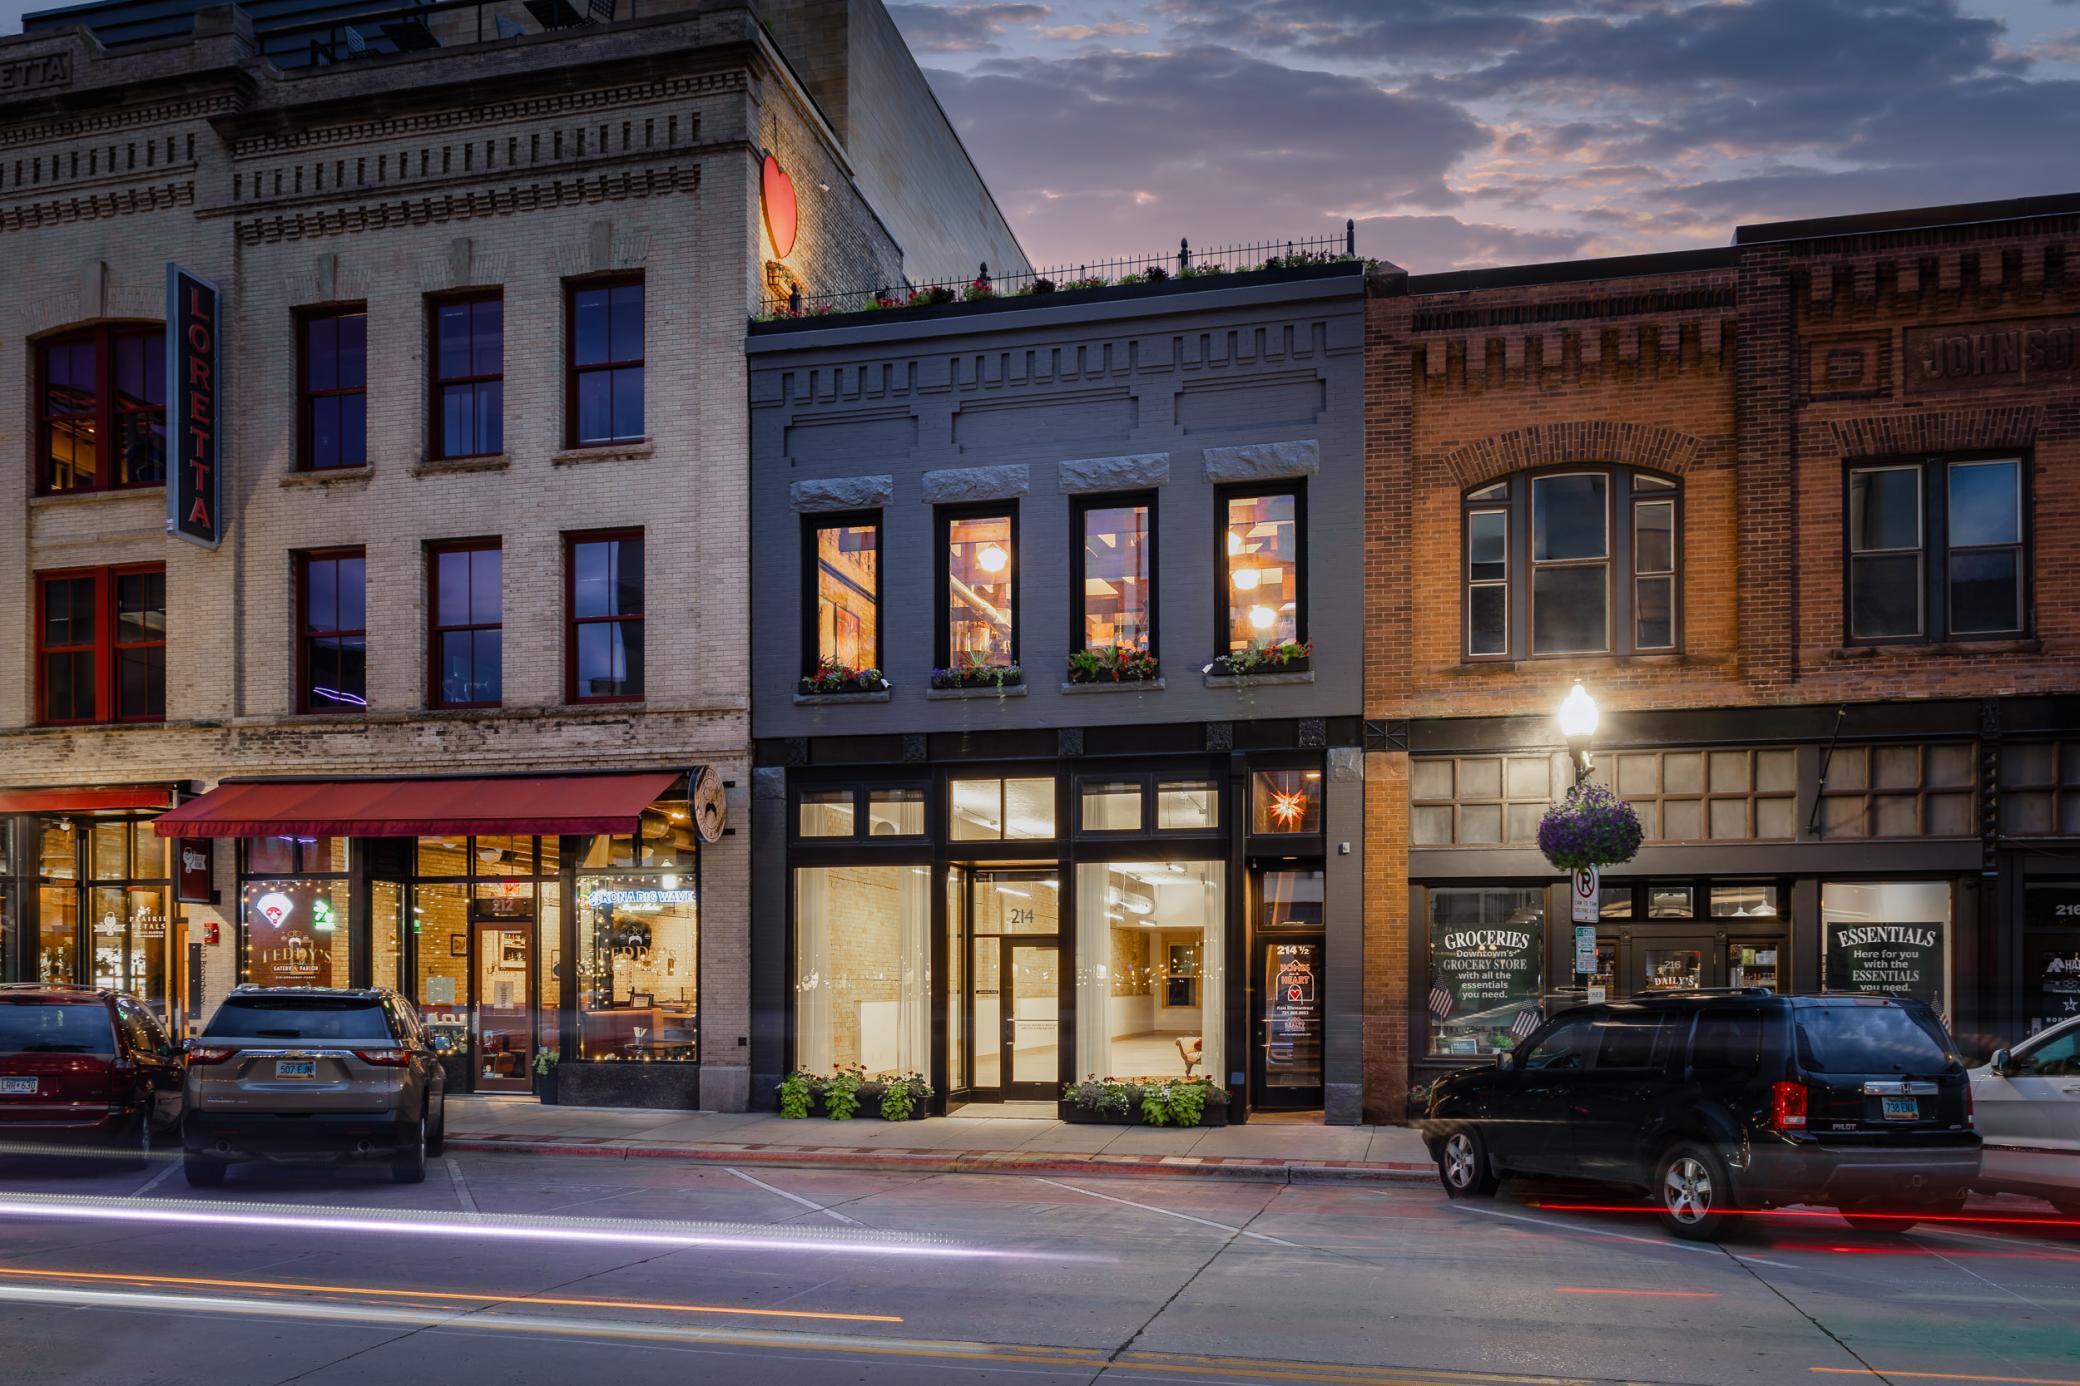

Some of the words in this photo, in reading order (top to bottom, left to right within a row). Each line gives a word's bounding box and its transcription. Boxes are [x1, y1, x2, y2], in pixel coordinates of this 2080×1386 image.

[188, 286, 211, 529] LORETTA
[491, 899, 514, 912] 212
[1010, 907, 1035, 925] 214
[1444, 930, 1531, 950] GROCERIES
[1837, 926, 1937, 948] ESSENTIALS
[1277, 946, 1297, 955] 214
[1456, 949, 1514, 958] Downtown's
[1853, 950, 1879, 958] Here
[1881, 949, 1897, 958] for
[1899, 951, 1919, 960] you
[1443, 959, 1491, 970] GROCERY
[1493, 959, 1527, 970] STORE
[1664, 961, 1681, 969] 216
[1864, 960, 1888, 968] with
[1891, 960, 1908, 969] the
[1281, 975, 1310, 984] HEART
[1458, 971, 1479, 980] with
[1481, 971, 1494, 980] all
[1496, 971, 1511, 980] the
[1852, 970, 1919, 981] ESSENTIALS
[1461, 980, 1508, 989] essentials
[1654, 976, 1695, 986] DAILY'S
[1882, 982, 1911, 991] need.
[1462, 991, 1480, 1000] you
[1482, 989, 1508, 999] need.
[280, 1065, 295, 1074] 507
